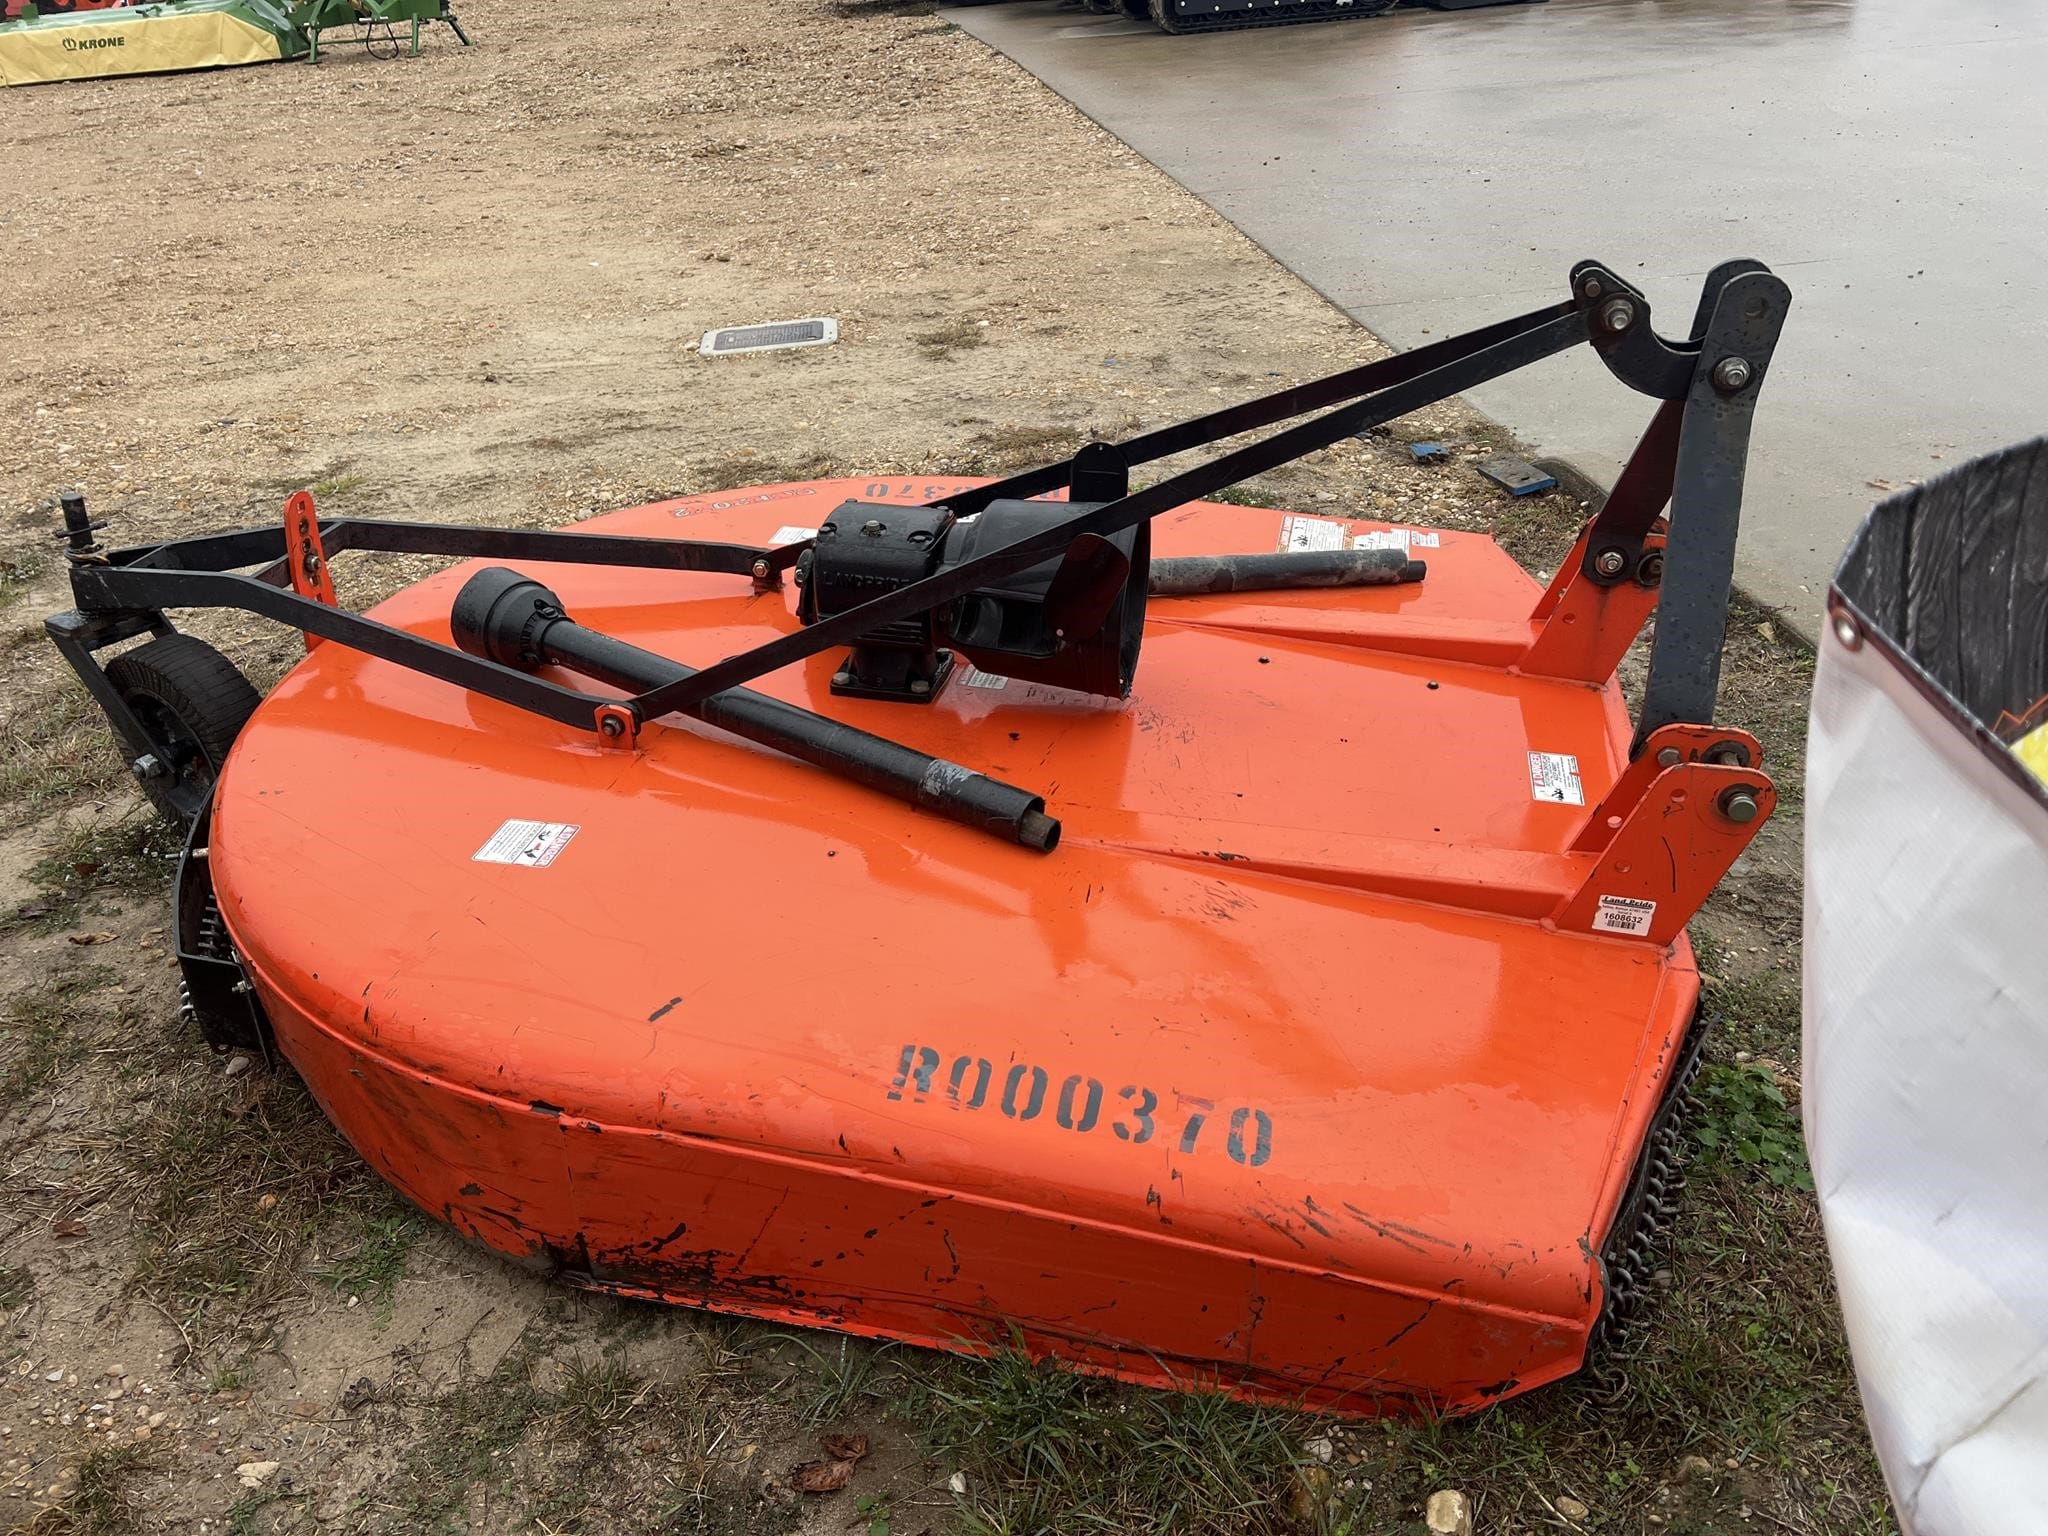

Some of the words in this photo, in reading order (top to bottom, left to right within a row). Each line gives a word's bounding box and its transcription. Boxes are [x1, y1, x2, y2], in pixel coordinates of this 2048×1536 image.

[79, 37, 124, 50] KRONE
[1602, 896, 1626, 905] Land
[1604, 912, 1643, 923] 1608632
[887, 1044, 1273, 1167] R000370
